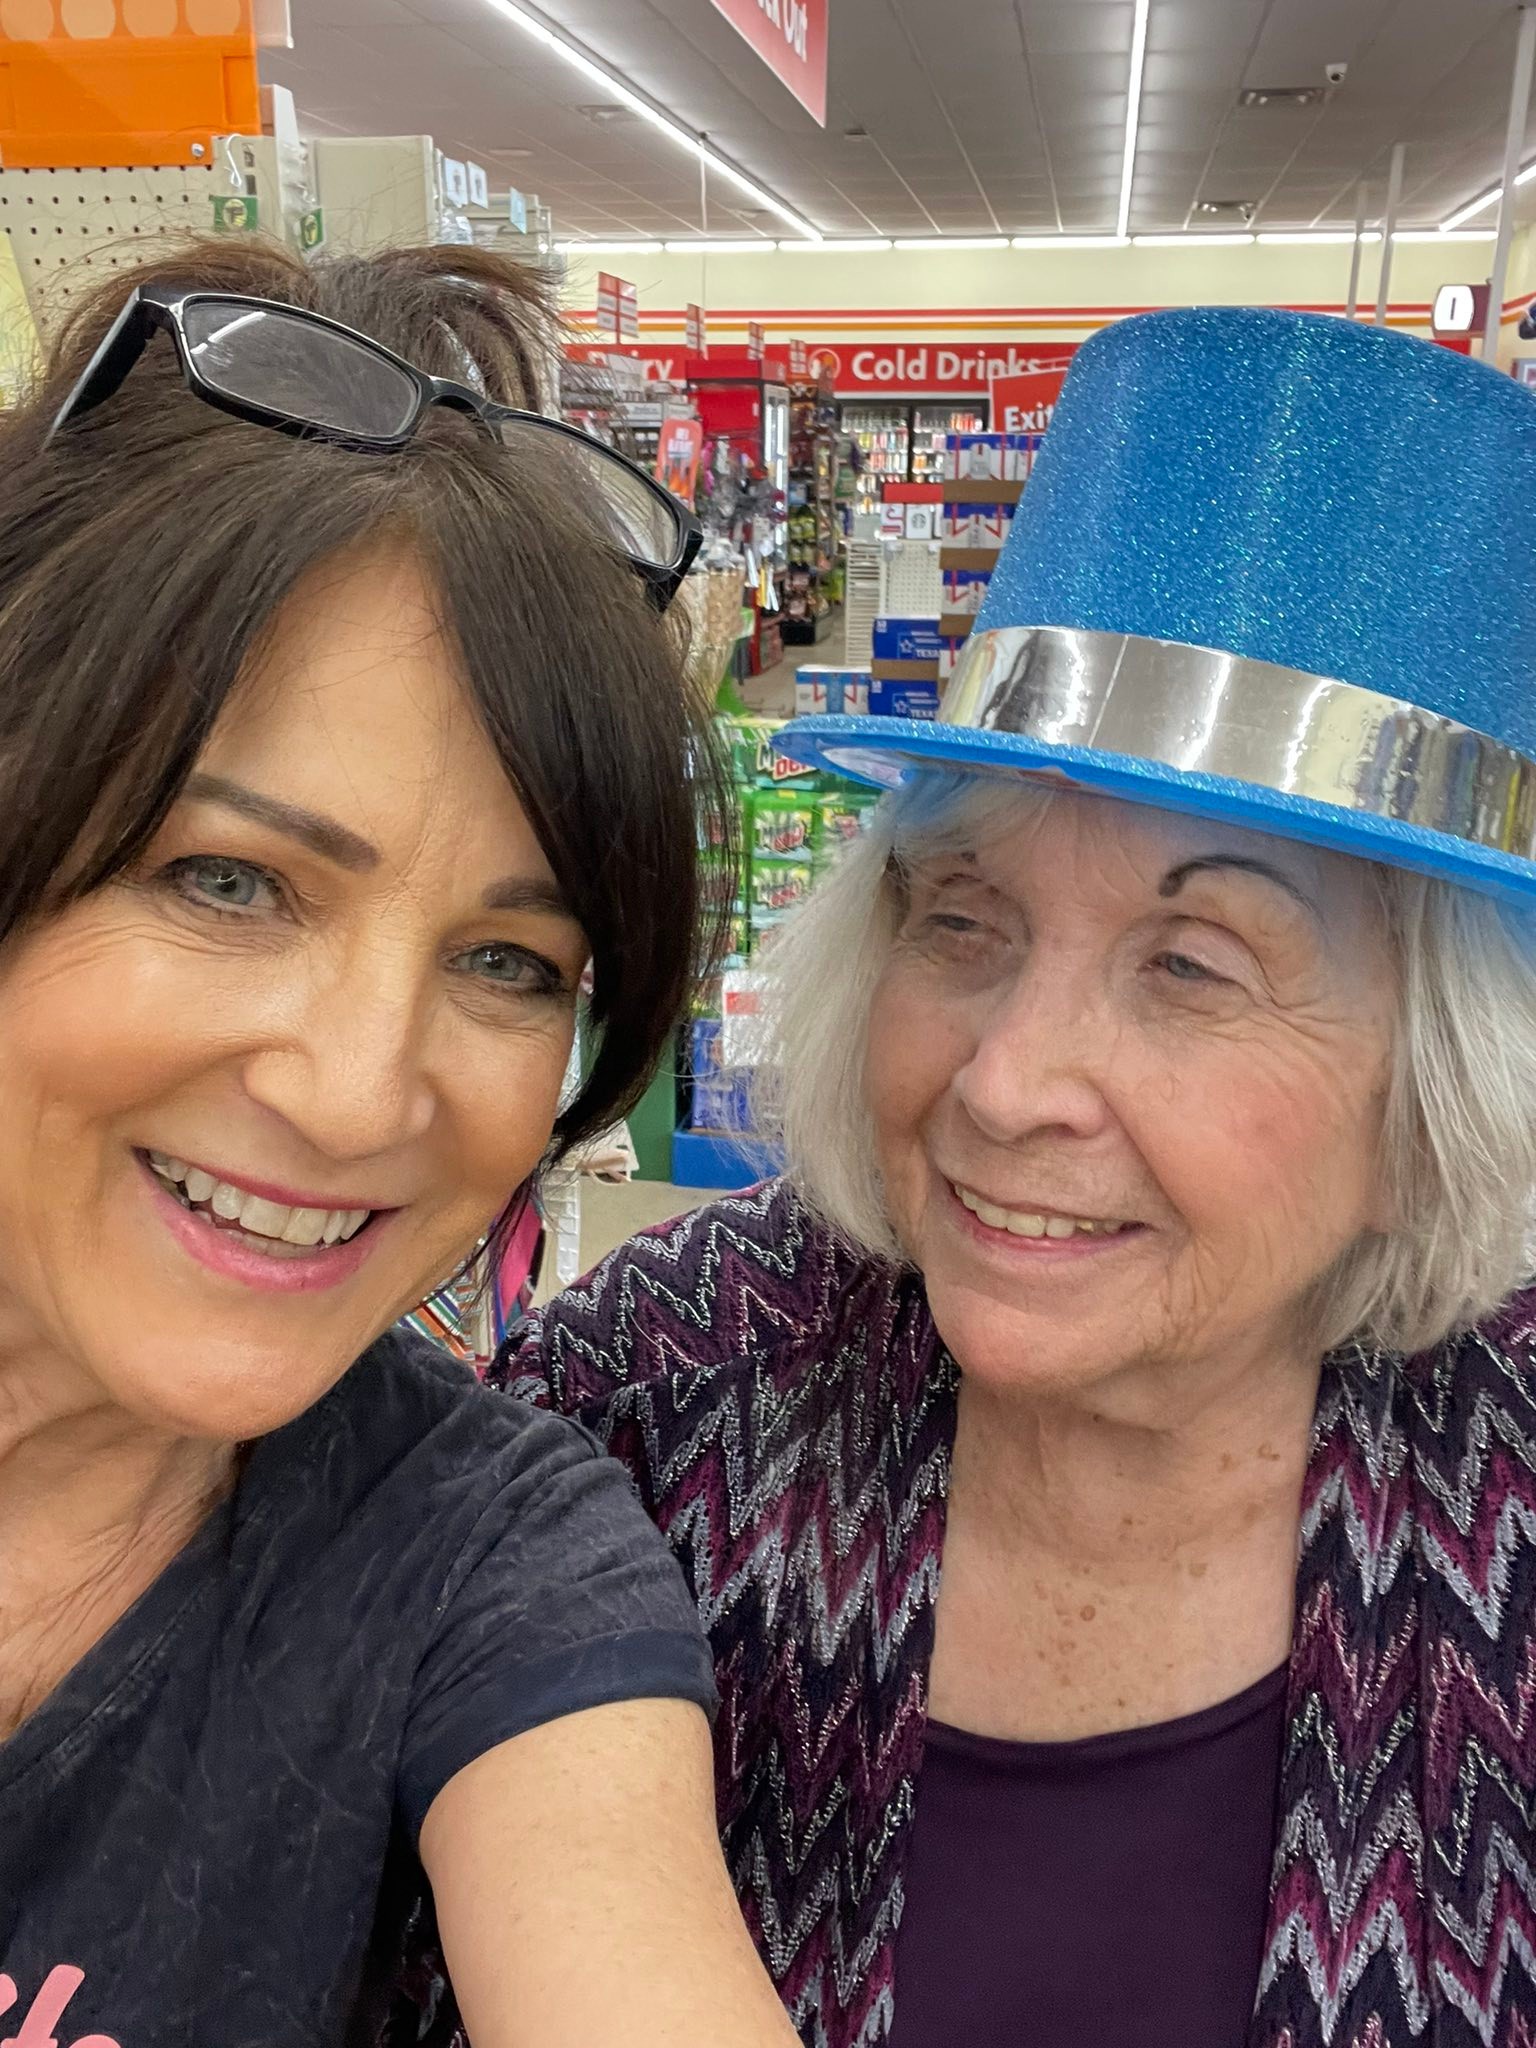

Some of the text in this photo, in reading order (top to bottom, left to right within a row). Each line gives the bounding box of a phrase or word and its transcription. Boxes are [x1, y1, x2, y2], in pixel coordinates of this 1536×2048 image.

[852, 347, 1040, 381] Cold Drinks
[1004, 401, 1054, 432] Exit
[915, 648, 938, 659] TEXA
